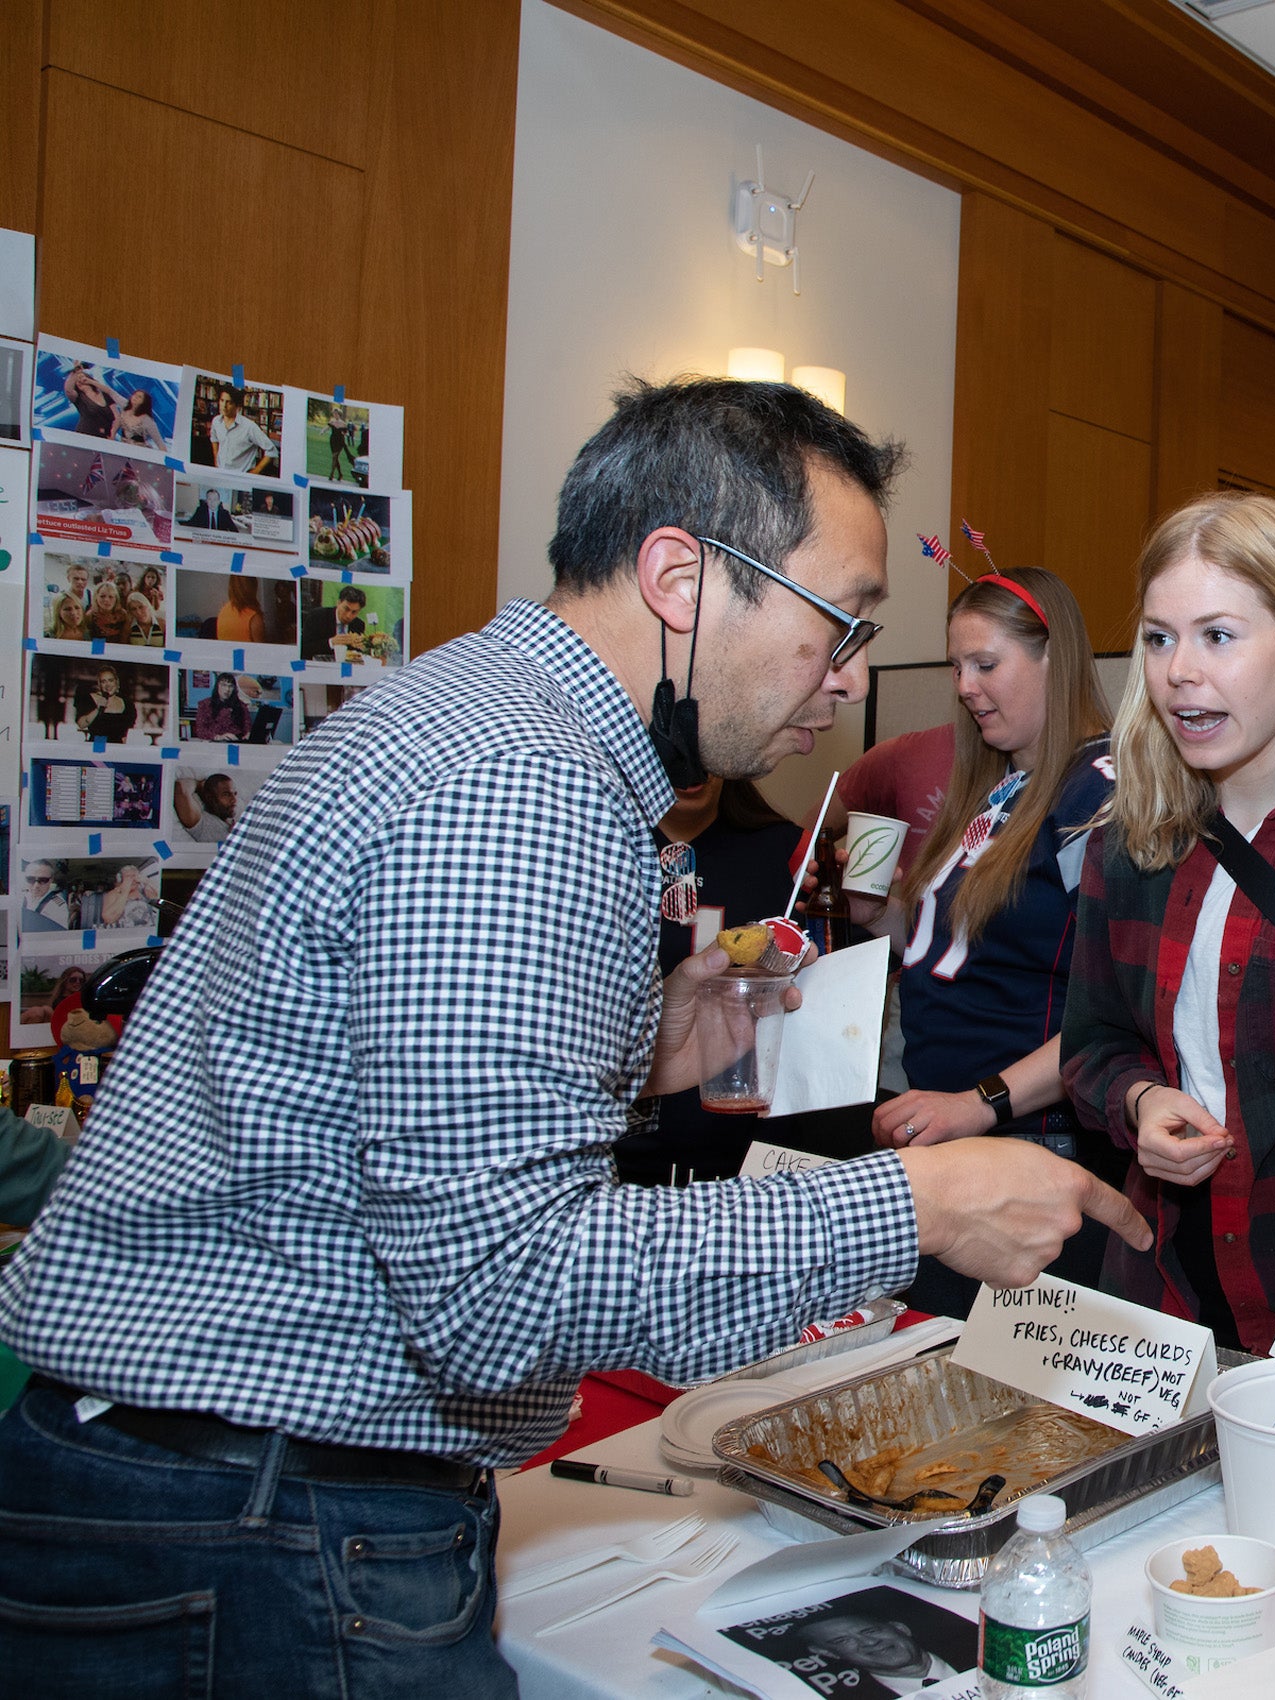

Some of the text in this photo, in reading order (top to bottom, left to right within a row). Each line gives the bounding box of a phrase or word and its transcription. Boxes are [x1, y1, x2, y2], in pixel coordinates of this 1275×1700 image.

[38, 518, 127, 537] ettuce outlasted Liz Truss
[993, 1288, 1077, 1315] POUTINE!!
[1013, 1322, 1193, 1367] FRIES, CHEESE CURDS
[1161, 1370, 1186, 1386] NOT
[1118, 1390, 1141, 1405] NOT
[1133, 1410, 1151, 1423] GF
[1159, 1386, 1181, 1410] VEG
[1025, 1625, 1080, 1662] Poland
[1122, 1646, 1151, 1671] CANDIES
[1127, 1625, 1151, 1646] MAPLE
[1148, 1643, 1172, 1668] SYRUP
[1026, 1643, 1081, 1680] Spring
